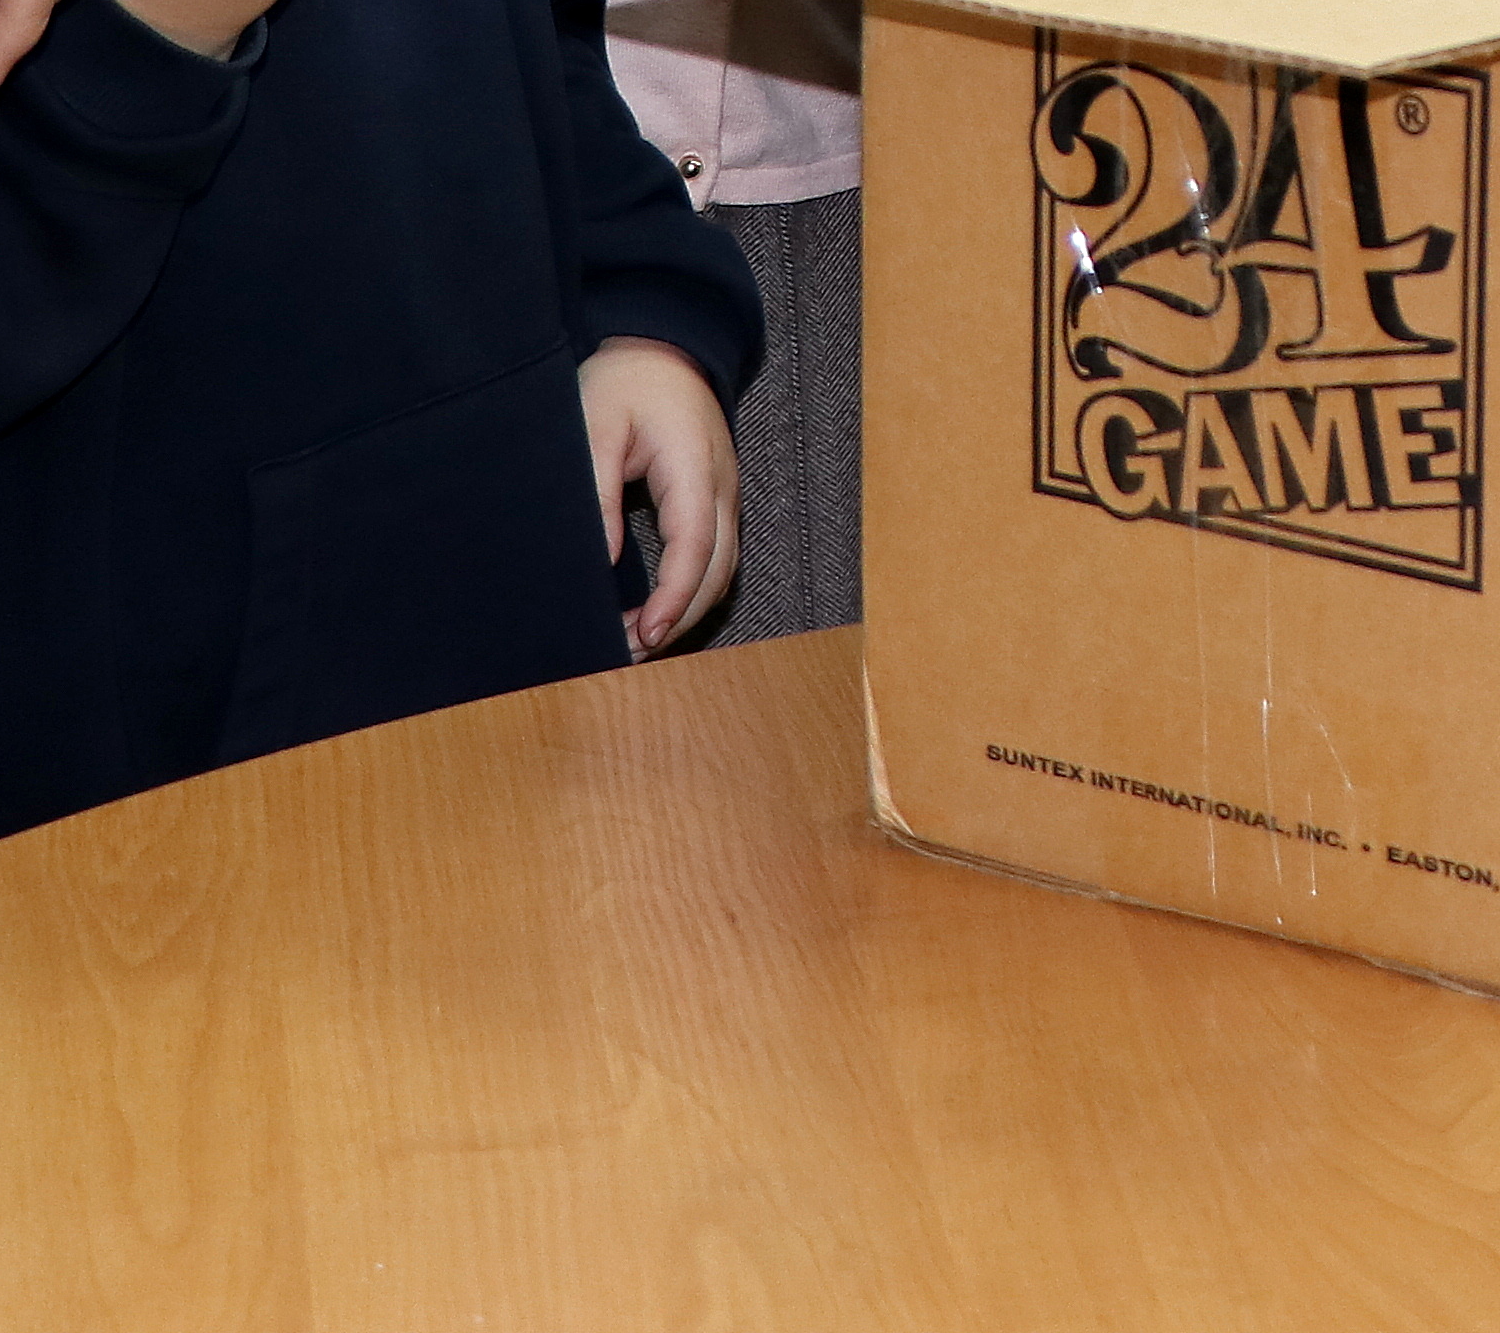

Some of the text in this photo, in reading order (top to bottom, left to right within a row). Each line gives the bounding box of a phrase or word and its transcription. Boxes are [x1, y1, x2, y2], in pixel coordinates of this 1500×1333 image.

[1031, 58, 1457, 381] 24
[1075, 383, 1466, 520] GAME
[985, 743, 1085, 784] SUNTEX
[1090, 770, 1293, 840] INTERNATIONAL,
[1295, 821, 1348, 851] INC.
[1386, 845, 1500, 893] EASTON,
